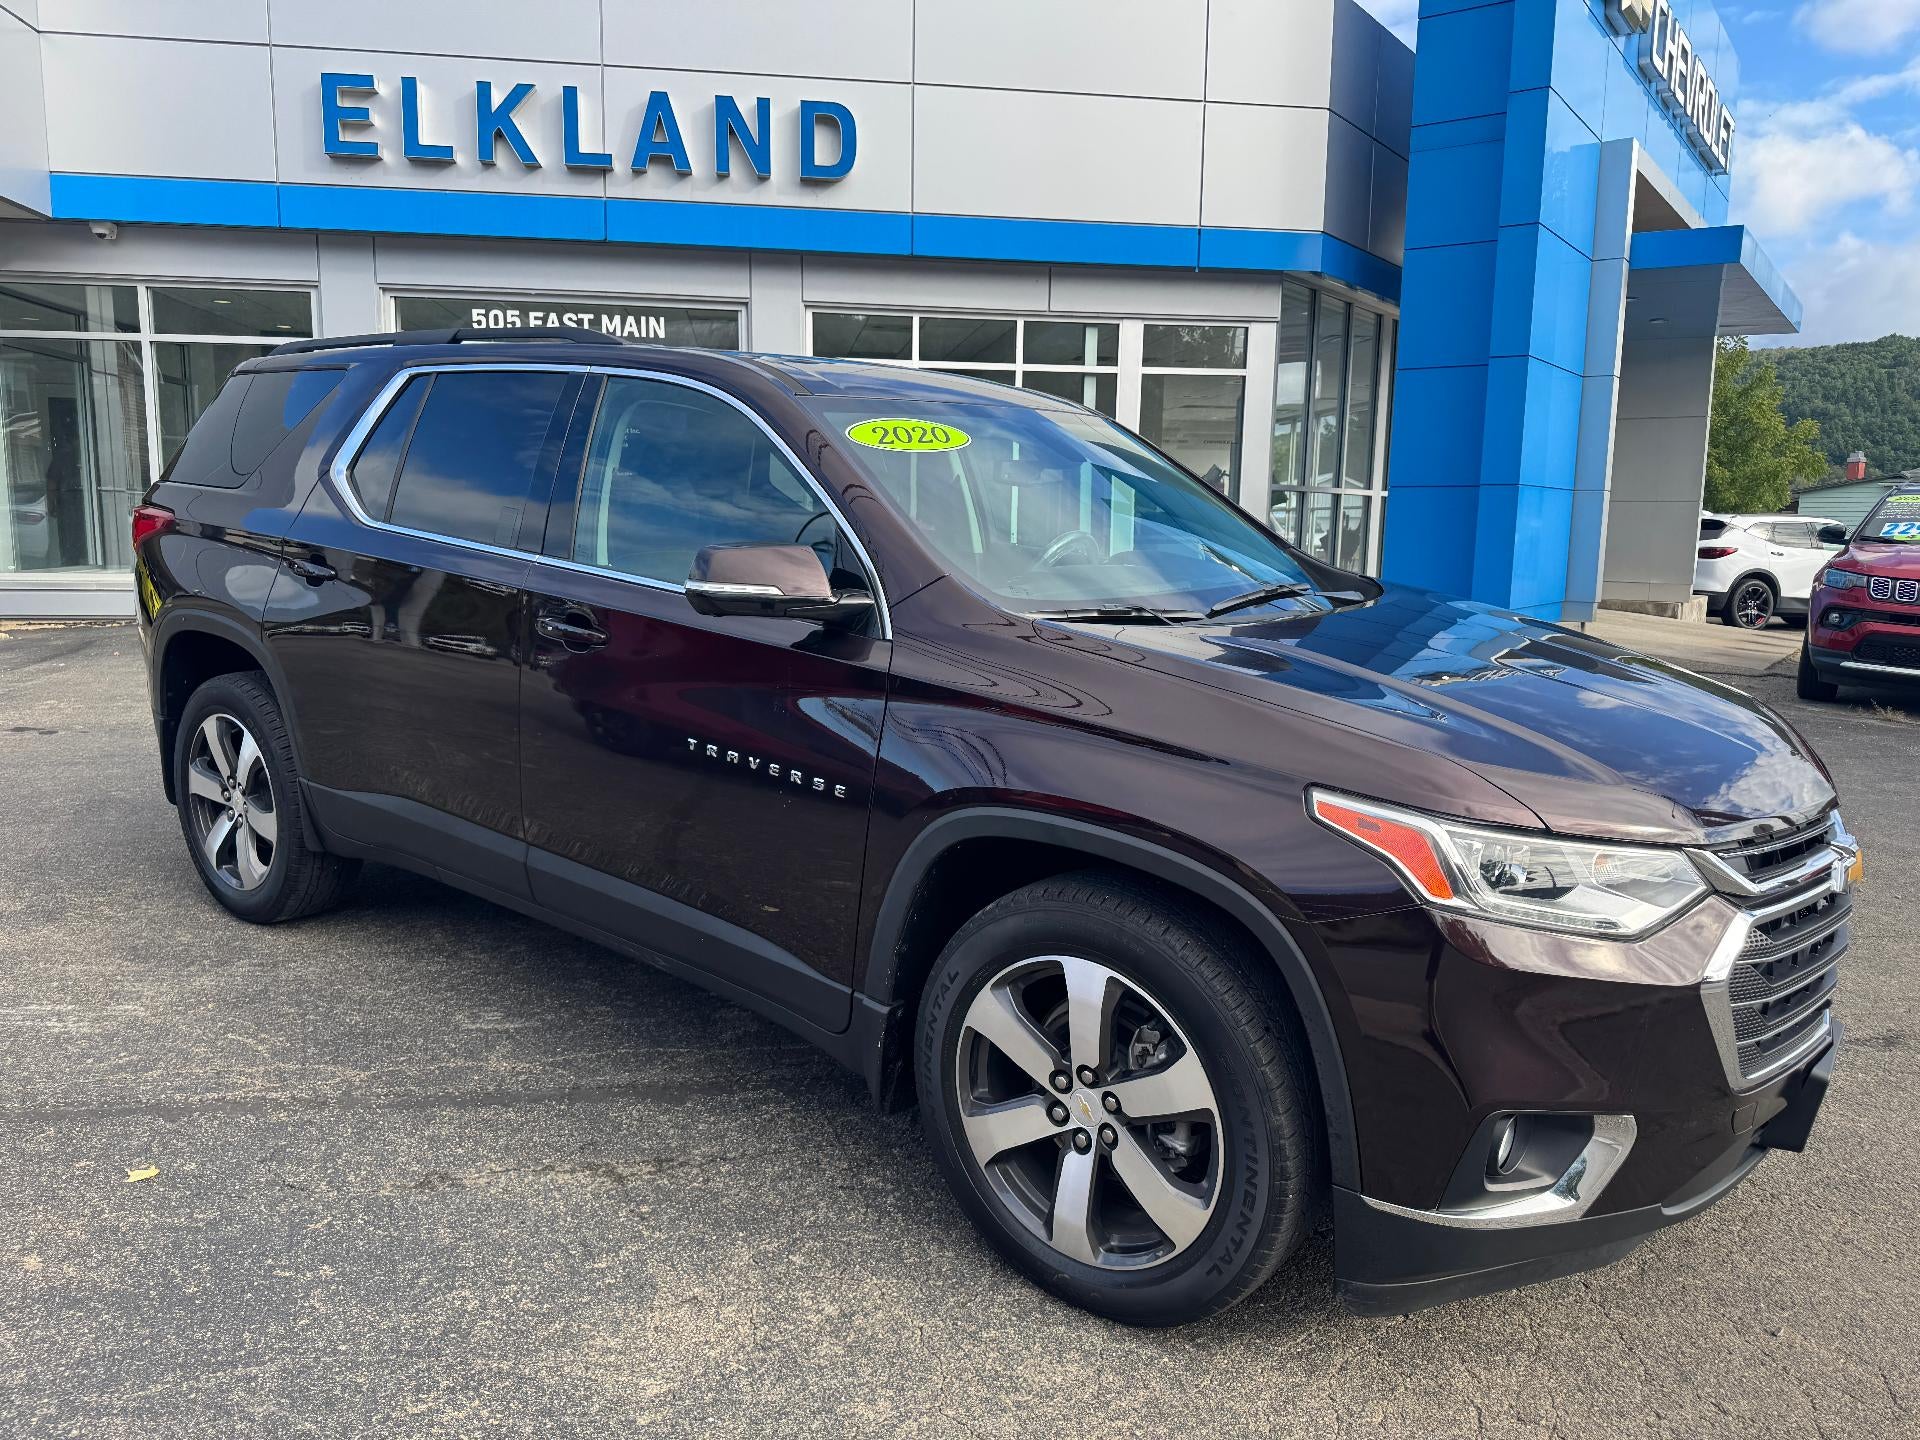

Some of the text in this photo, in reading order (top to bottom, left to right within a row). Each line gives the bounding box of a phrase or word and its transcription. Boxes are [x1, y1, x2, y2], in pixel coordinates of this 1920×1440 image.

[1650, 0, 1736, 175] CHEVROLET
[320, 72, 858, 182] ELKLAND
[471, 308, 665, 338] 505 EAST MAIN
[871, 426, 951, 445] 2020
[687, 737, 847, 799] TRAVERSE
